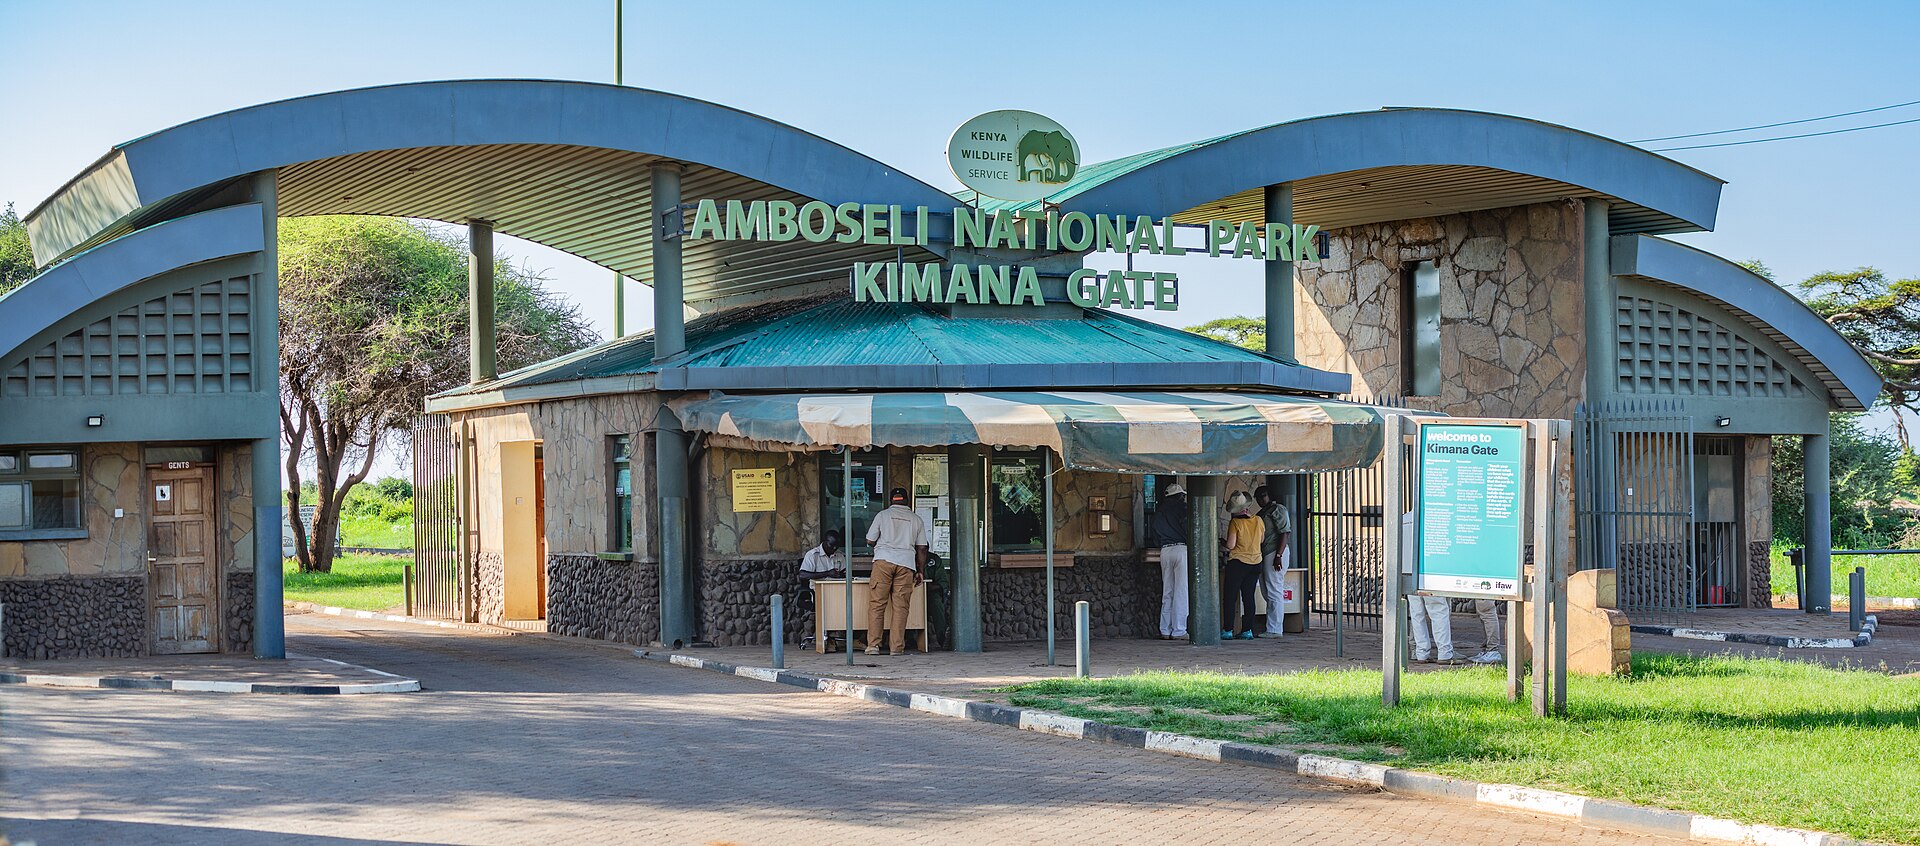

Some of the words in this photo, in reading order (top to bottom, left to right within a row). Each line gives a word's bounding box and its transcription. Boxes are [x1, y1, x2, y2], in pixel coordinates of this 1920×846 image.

[971, 131, 1007, 142] KENYA
[961, 149, 1013, 162] WILDLIFE
[968, 168, 1009, 180] SERVICE
[690, 199, 929, 246] AMBOSELI
[953, 206, 1187, 256] NATIONAL
[1209, 219, 1321, 263] PARK
[854, 261, 1046, 307] KIMANA
[1066, 268, 1179, 311] GATE
[1427, 431, 1478, 443] welcome
[1479, 433, 1492, 443] to
[1427, 443, 1469, 454] Kimana
[1471, 445, 1499, 455] Gate
[168, 461, 190, 469] GENTS
[1496, 581, 1512, 589] ifaw
